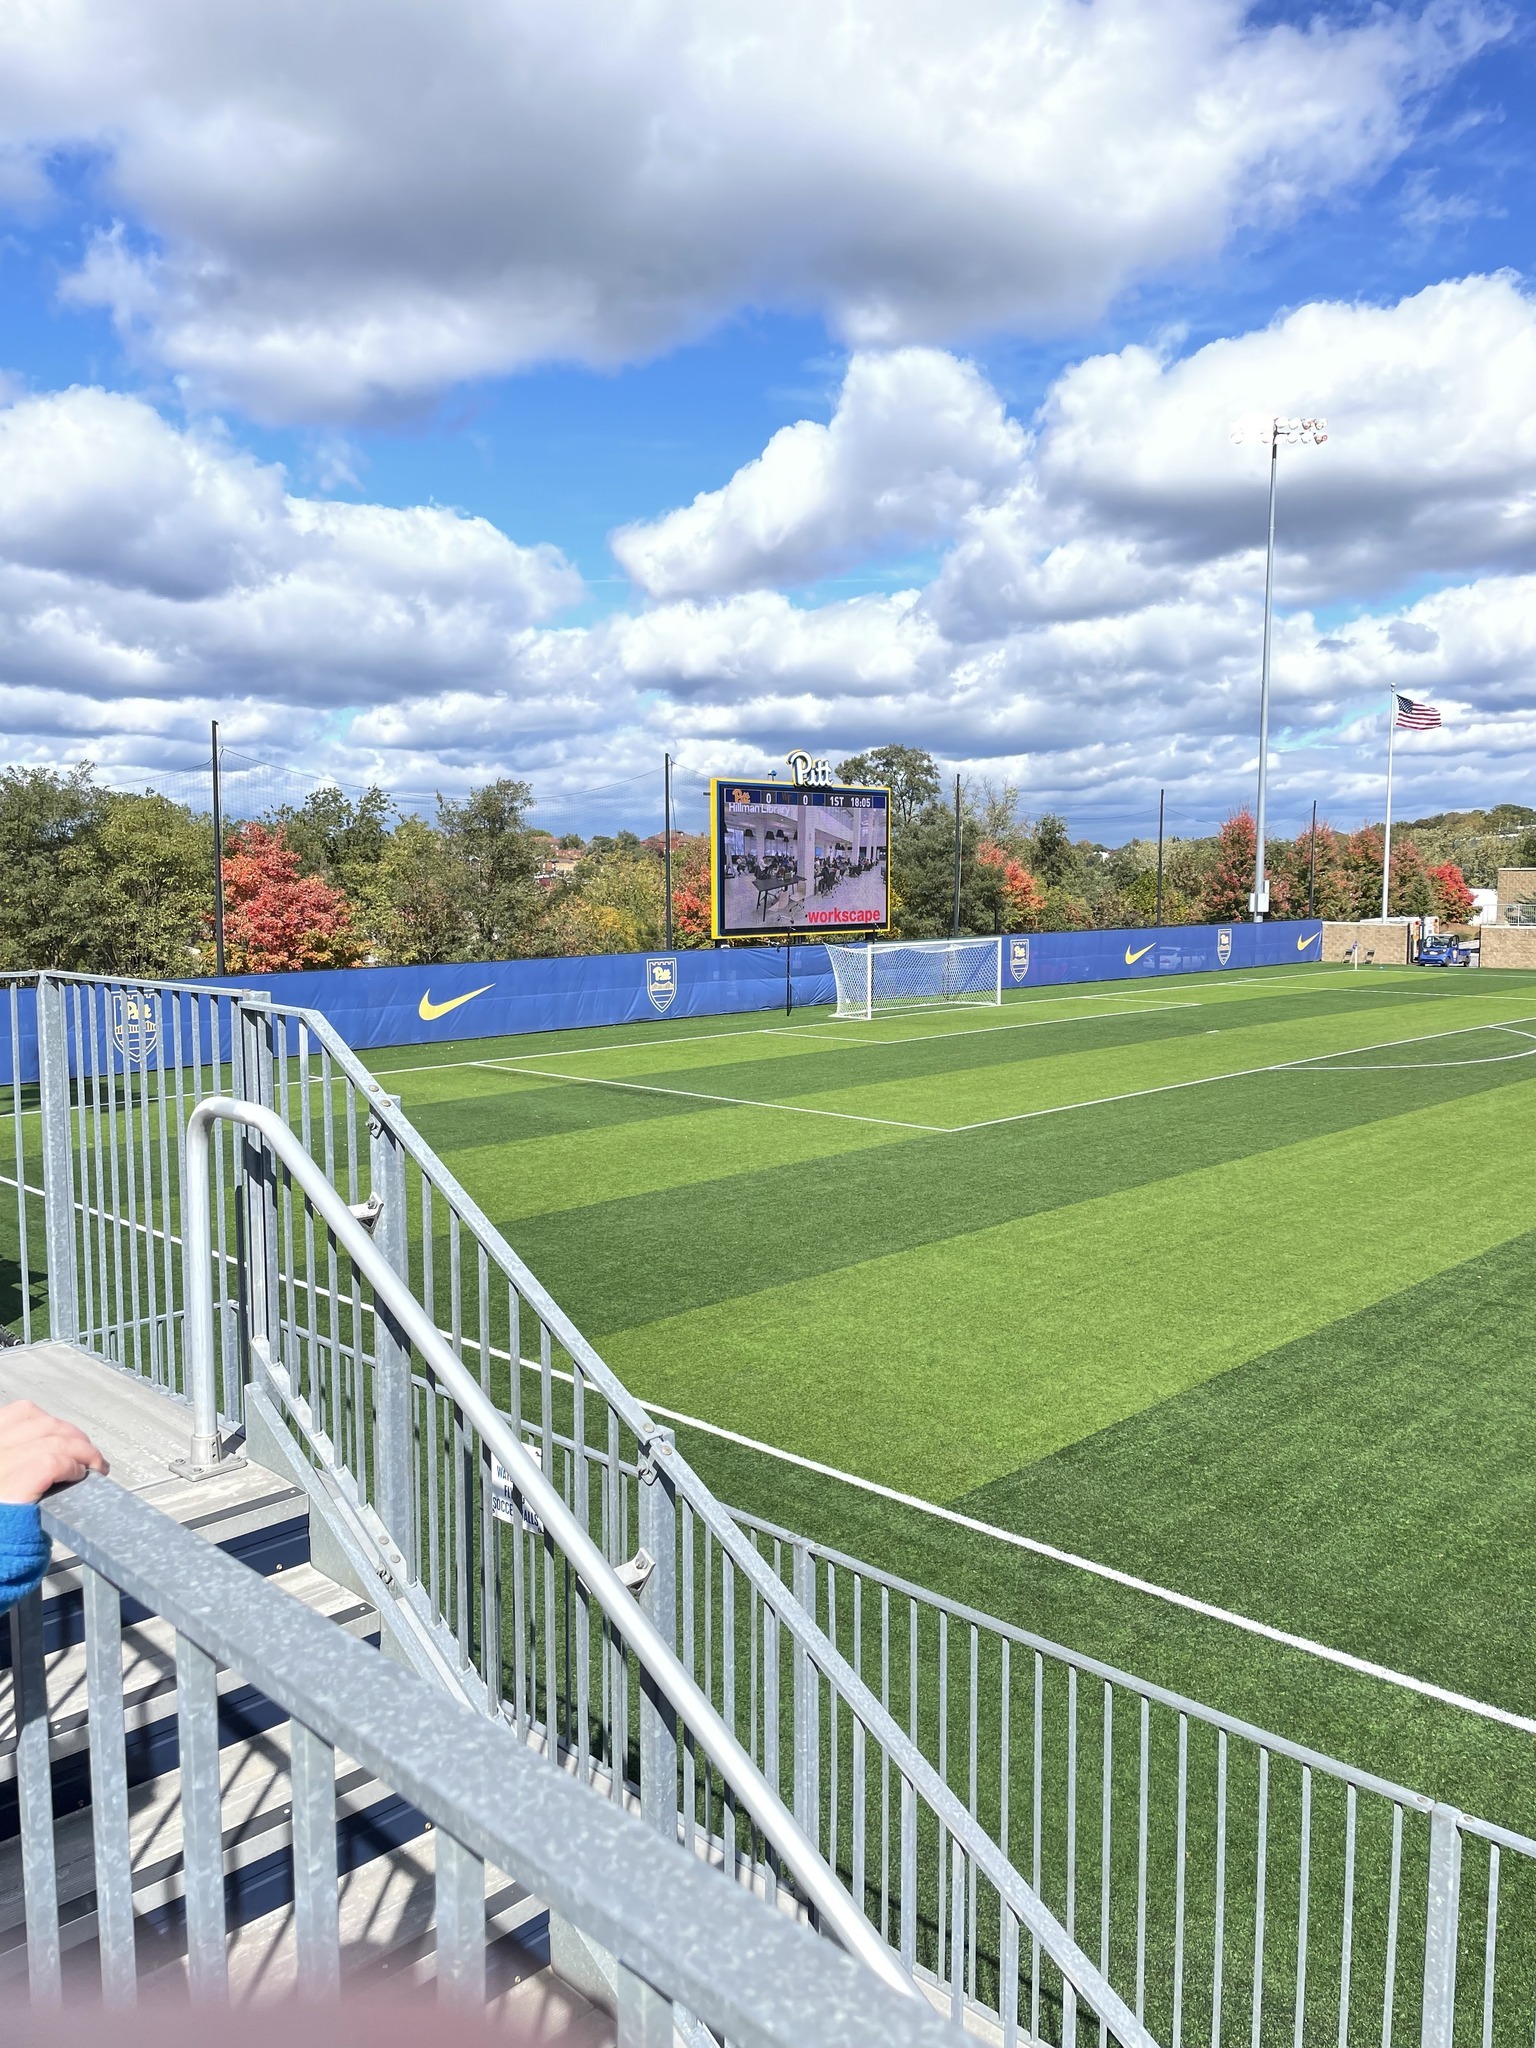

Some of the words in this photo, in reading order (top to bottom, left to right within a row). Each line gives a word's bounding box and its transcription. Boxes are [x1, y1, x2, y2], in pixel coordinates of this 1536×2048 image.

[786, 749, 834, 787] Pitt
[766, 793, 772, 804] 0
[803, 795, 808, 805] 0
[830, 796, 845, 807] 1ST
[851, 797, 871, 808] 18:05
[728, 802, 760, 813] Hillman
[761, 804, 791, 816] Library
[807, 907, 881, 923] workscape
